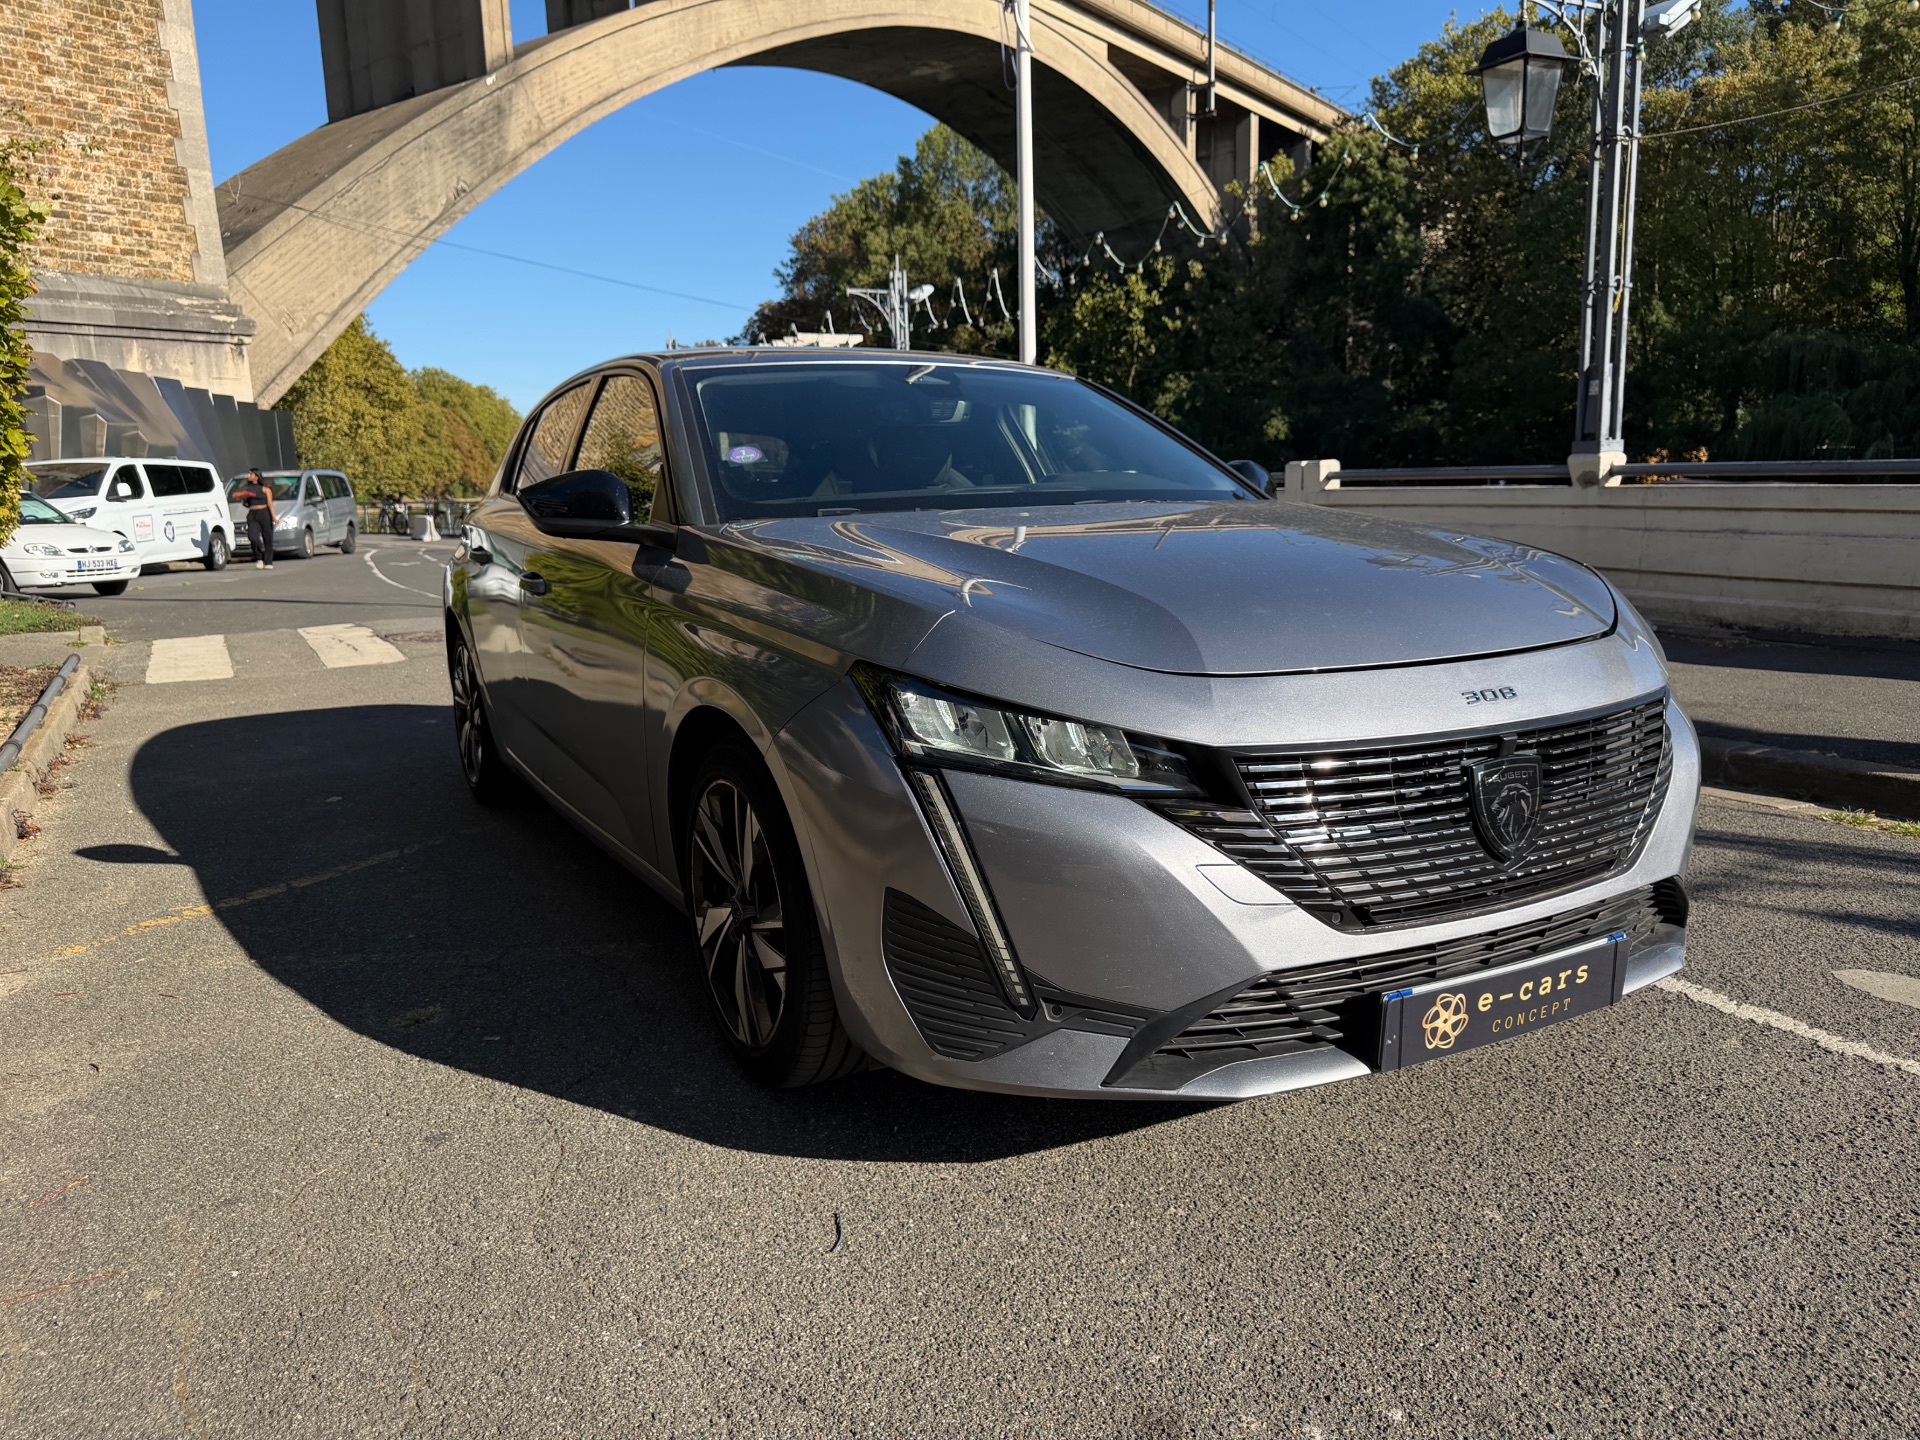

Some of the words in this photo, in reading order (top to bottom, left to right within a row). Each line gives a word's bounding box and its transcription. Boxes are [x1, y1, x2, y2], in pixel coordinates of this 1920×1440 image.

[1461, 686, 1518, 705] 308
[1477, 964, 1589, 1012] e-cars
[1492, 998, 1571, 1033] CONCEPT
